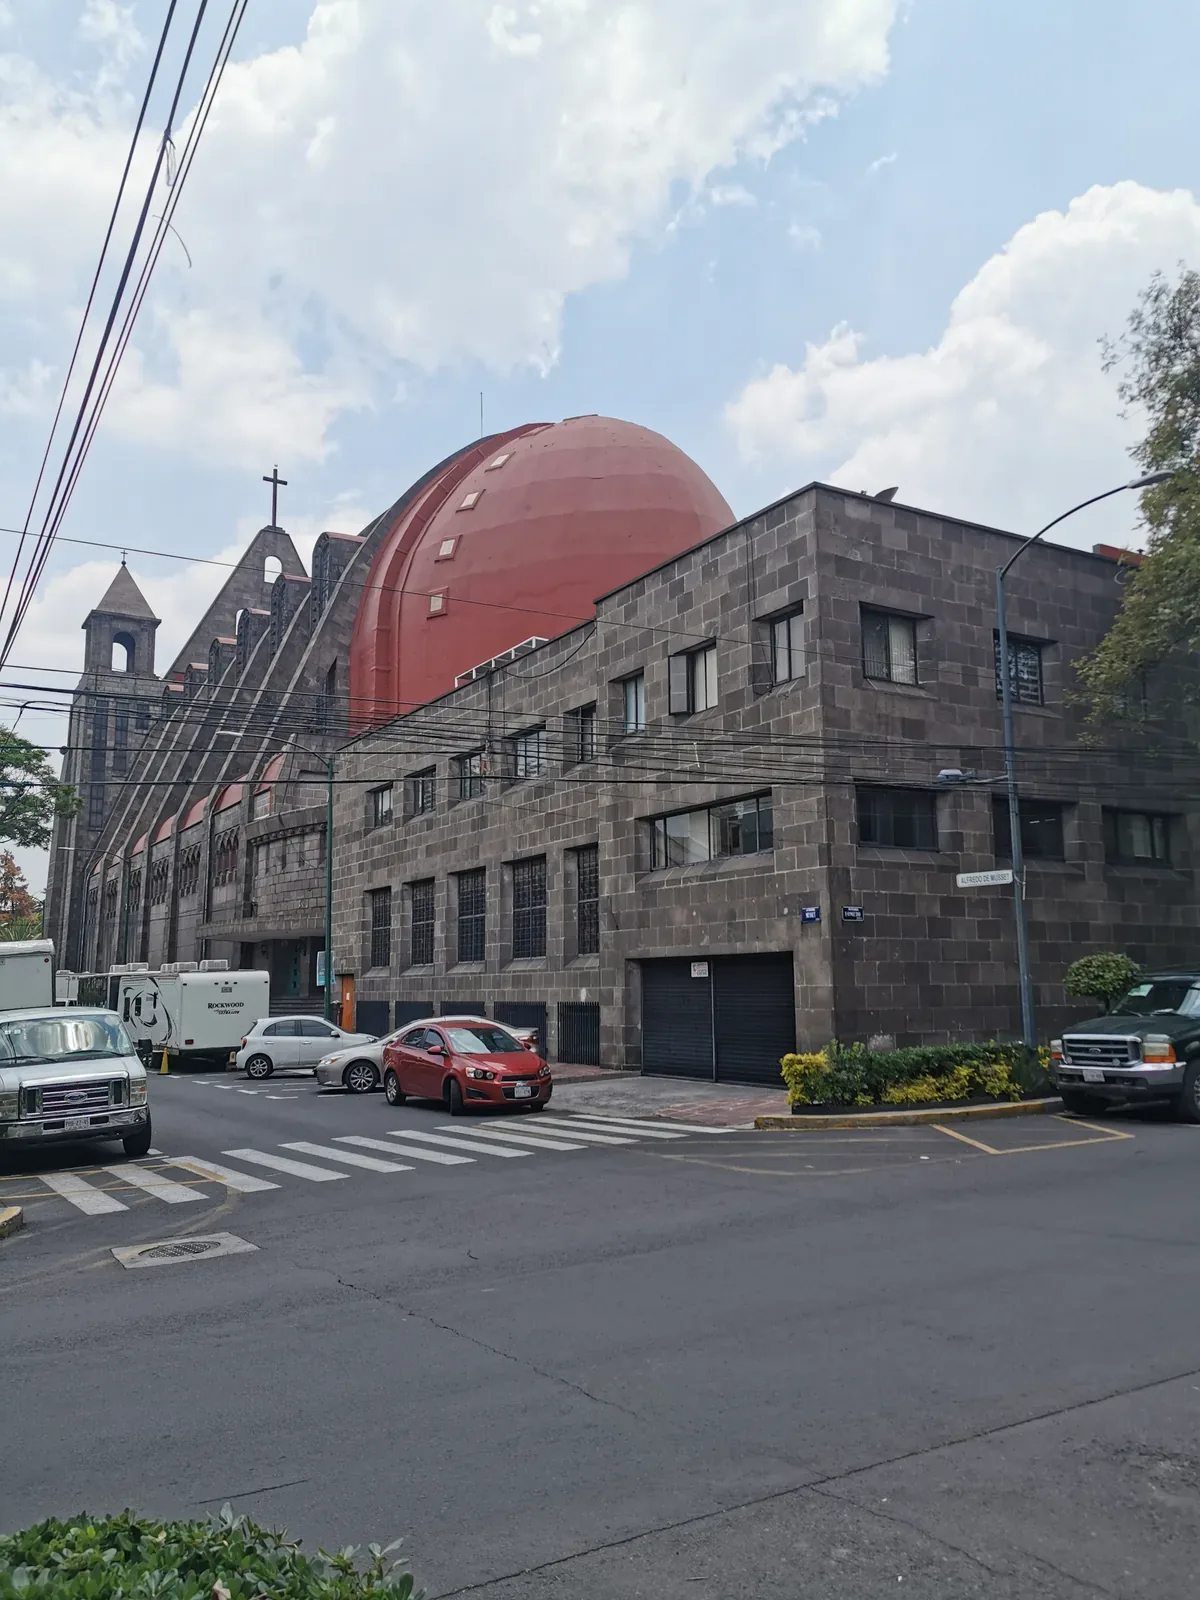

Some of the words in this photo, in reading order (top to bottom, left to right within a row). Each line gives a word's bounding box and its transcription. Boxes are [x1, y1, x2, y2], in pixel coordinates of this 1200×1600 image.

[961, 875, 983, 884] ALFREDO
[983, 874, 990, 883] DE
[990, 873, 1010, 882] MUSSET
